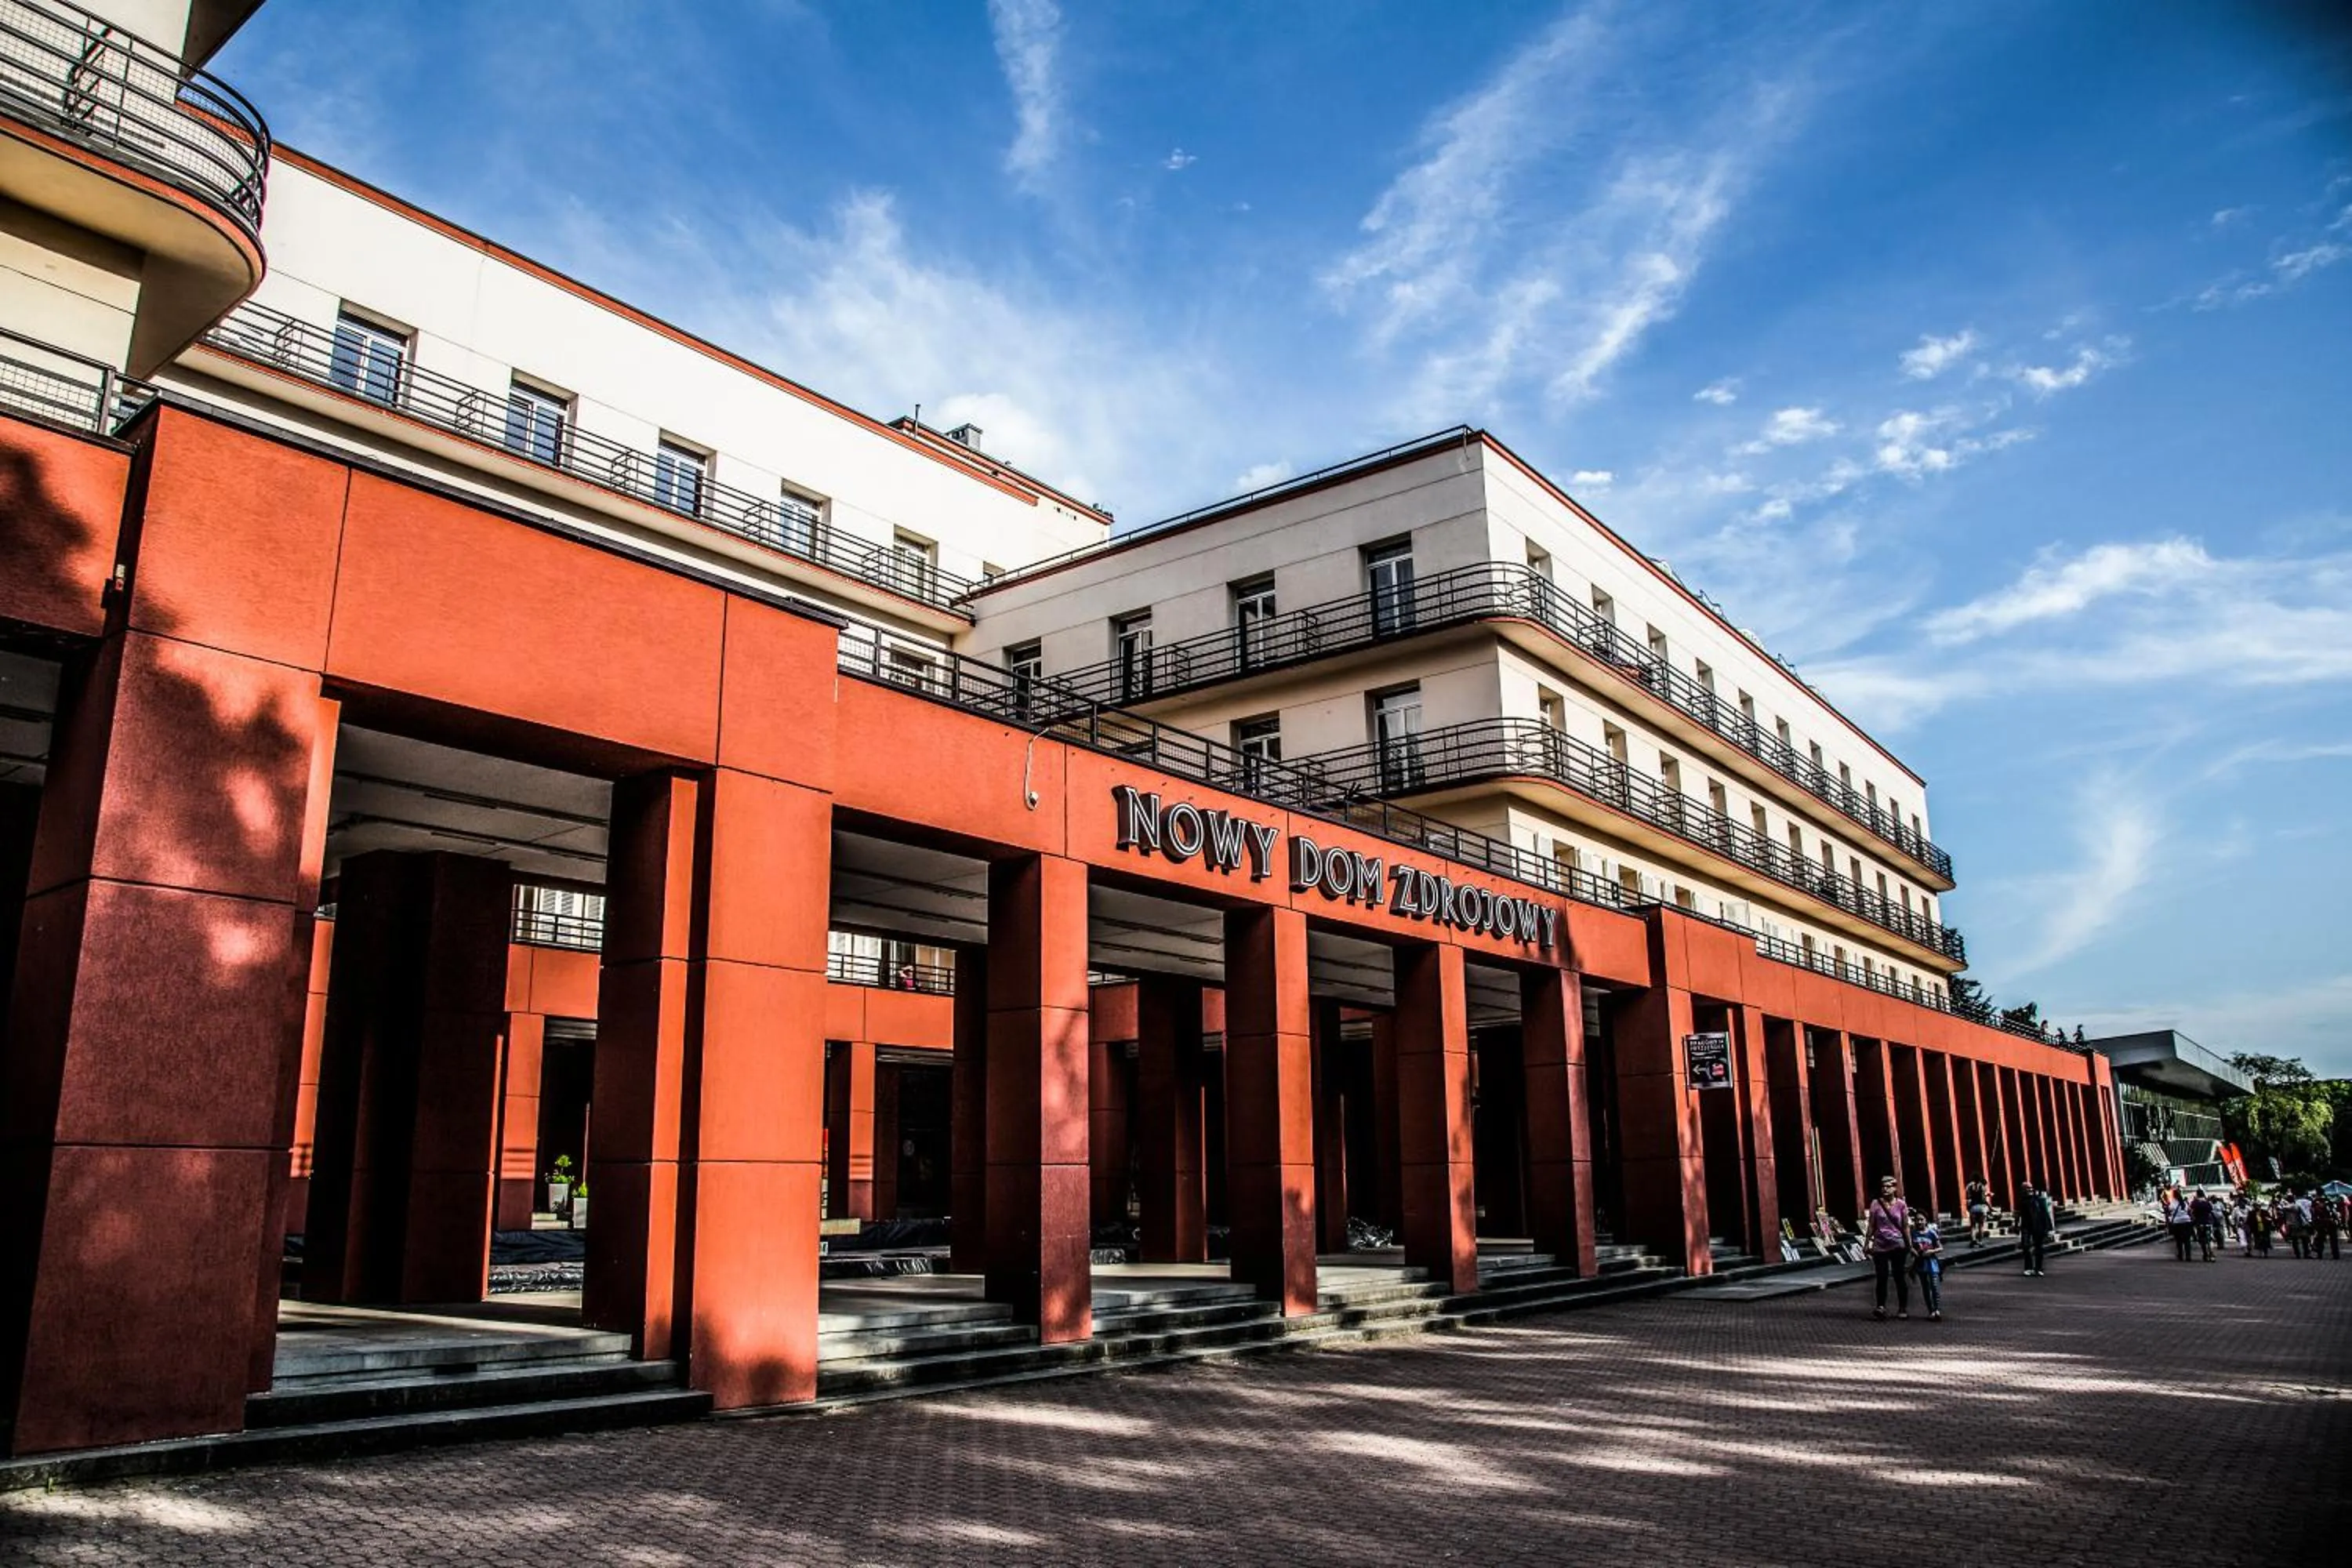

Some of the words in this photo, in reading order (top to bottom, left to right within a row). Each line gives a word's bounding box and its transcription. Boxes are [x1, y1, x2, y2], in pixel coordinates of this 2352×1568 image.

[1112, 785, 1279, 882] NOWY
[1288, 836, 1385, 908] DOM
[1388, 863, 1556, 948] ZDROJOWY
